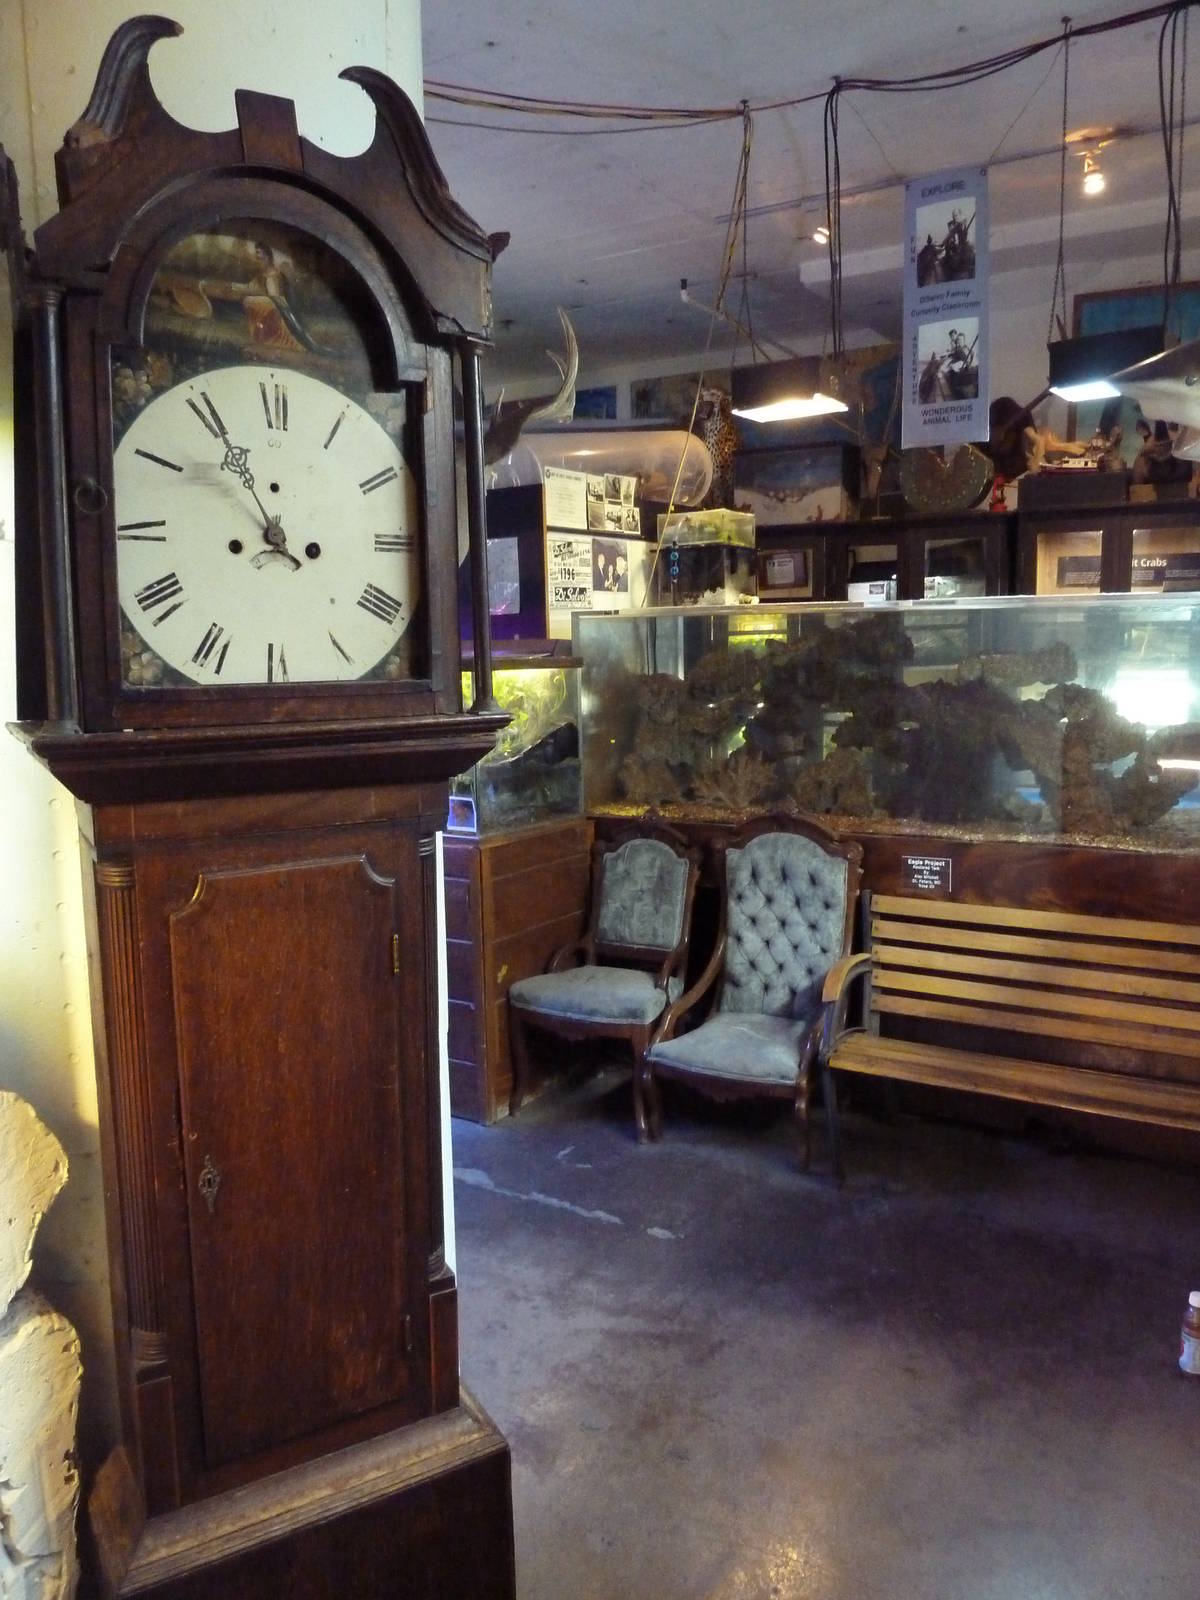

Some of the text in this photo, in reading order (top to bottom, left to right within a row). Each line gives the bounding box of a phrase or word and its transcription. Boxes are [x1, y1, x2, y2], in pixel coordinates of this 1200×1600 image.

[921, 404, 974, 417] WONDEROUS
[922, 414, 973, 425] ANIMAL LIFE
[1140, 557, 1167, 567] Crabs
